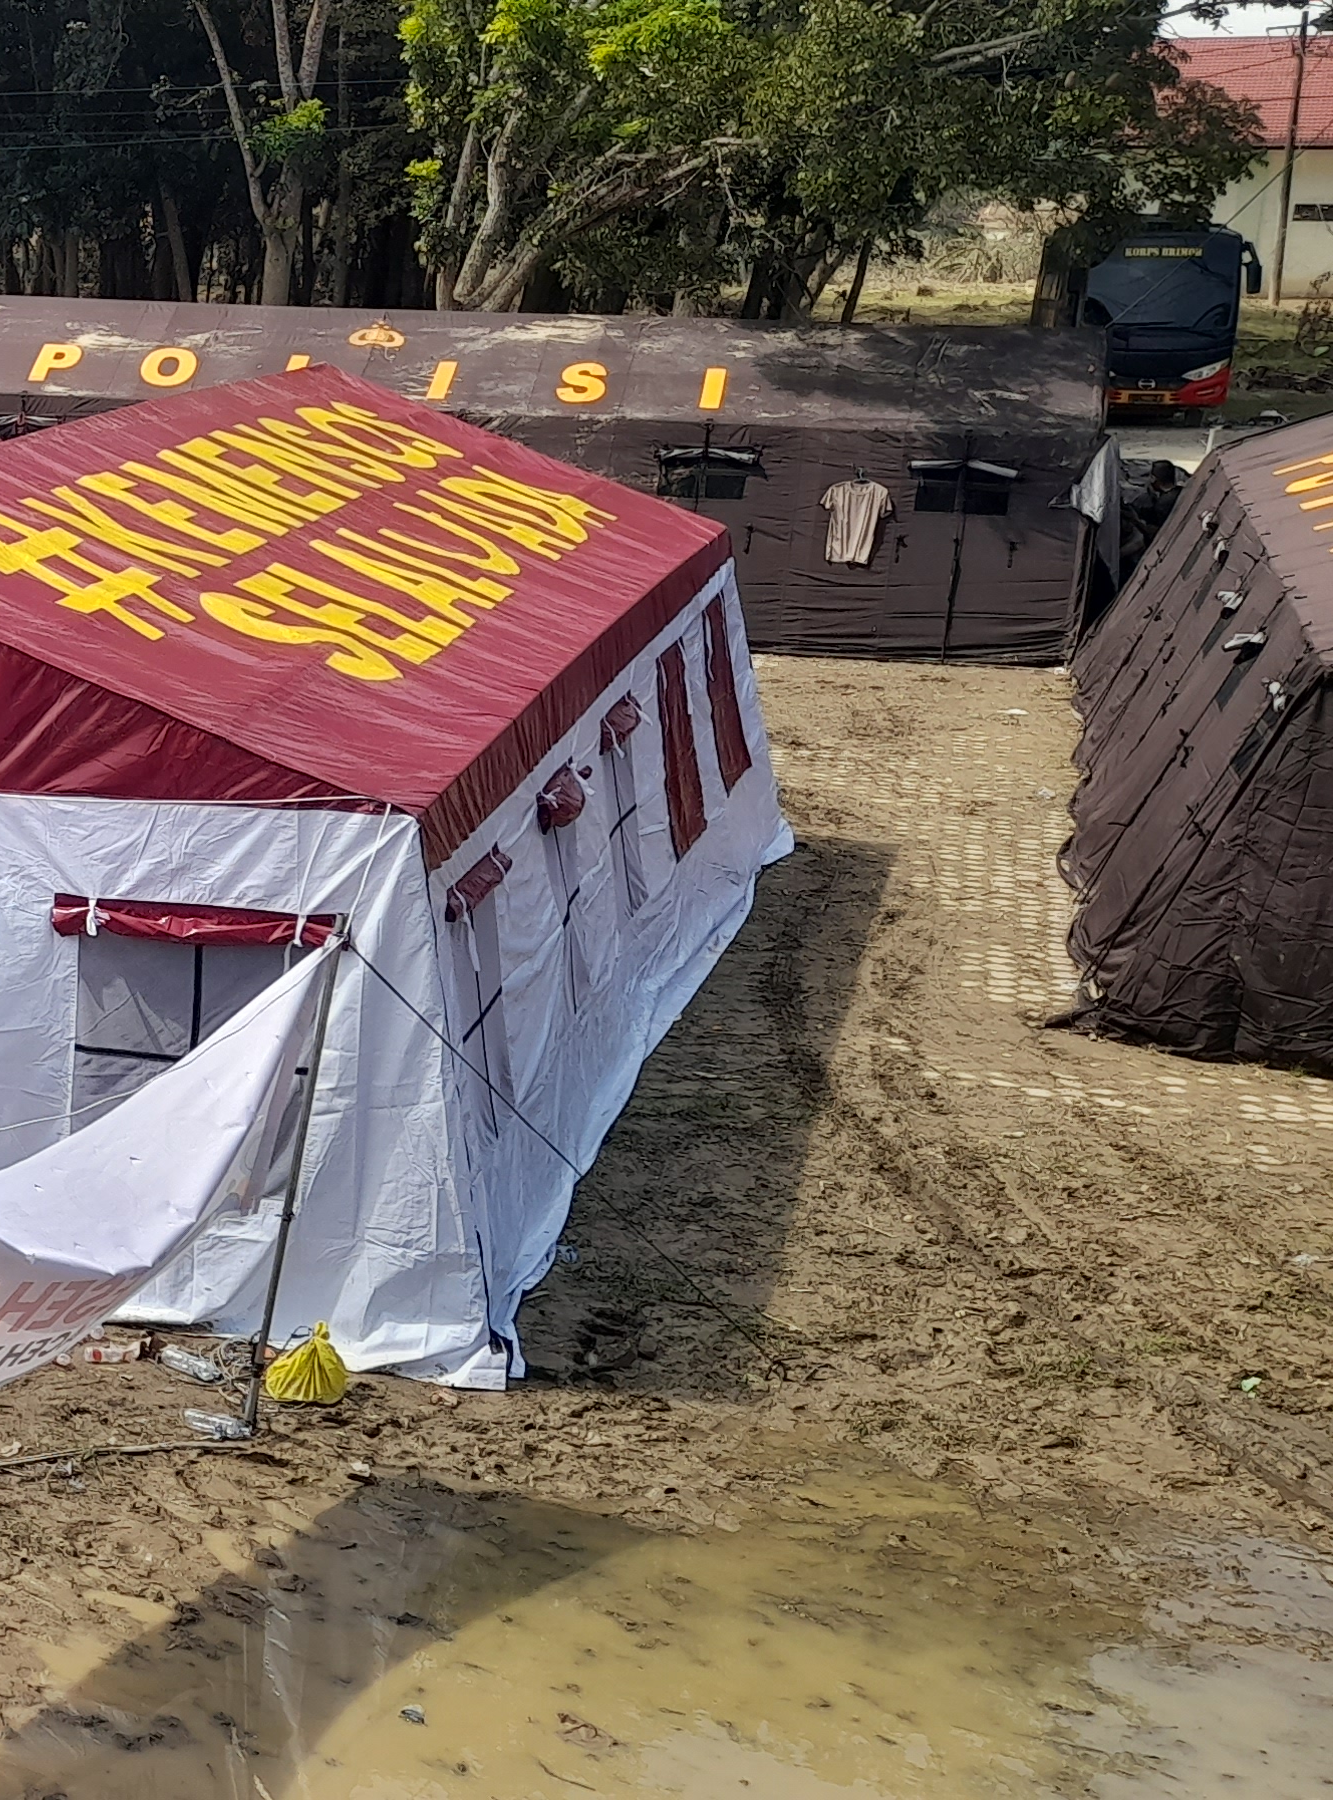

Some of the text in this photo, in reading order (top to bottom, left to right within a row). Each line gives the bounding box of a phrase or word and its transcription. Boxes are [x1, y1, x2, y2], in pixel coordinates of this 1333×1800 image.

[1124, 247, 1160, 257] KORPS
[27, 341, 729, 410] POISI
[199, 464, 619, 681] SELALU ADA
